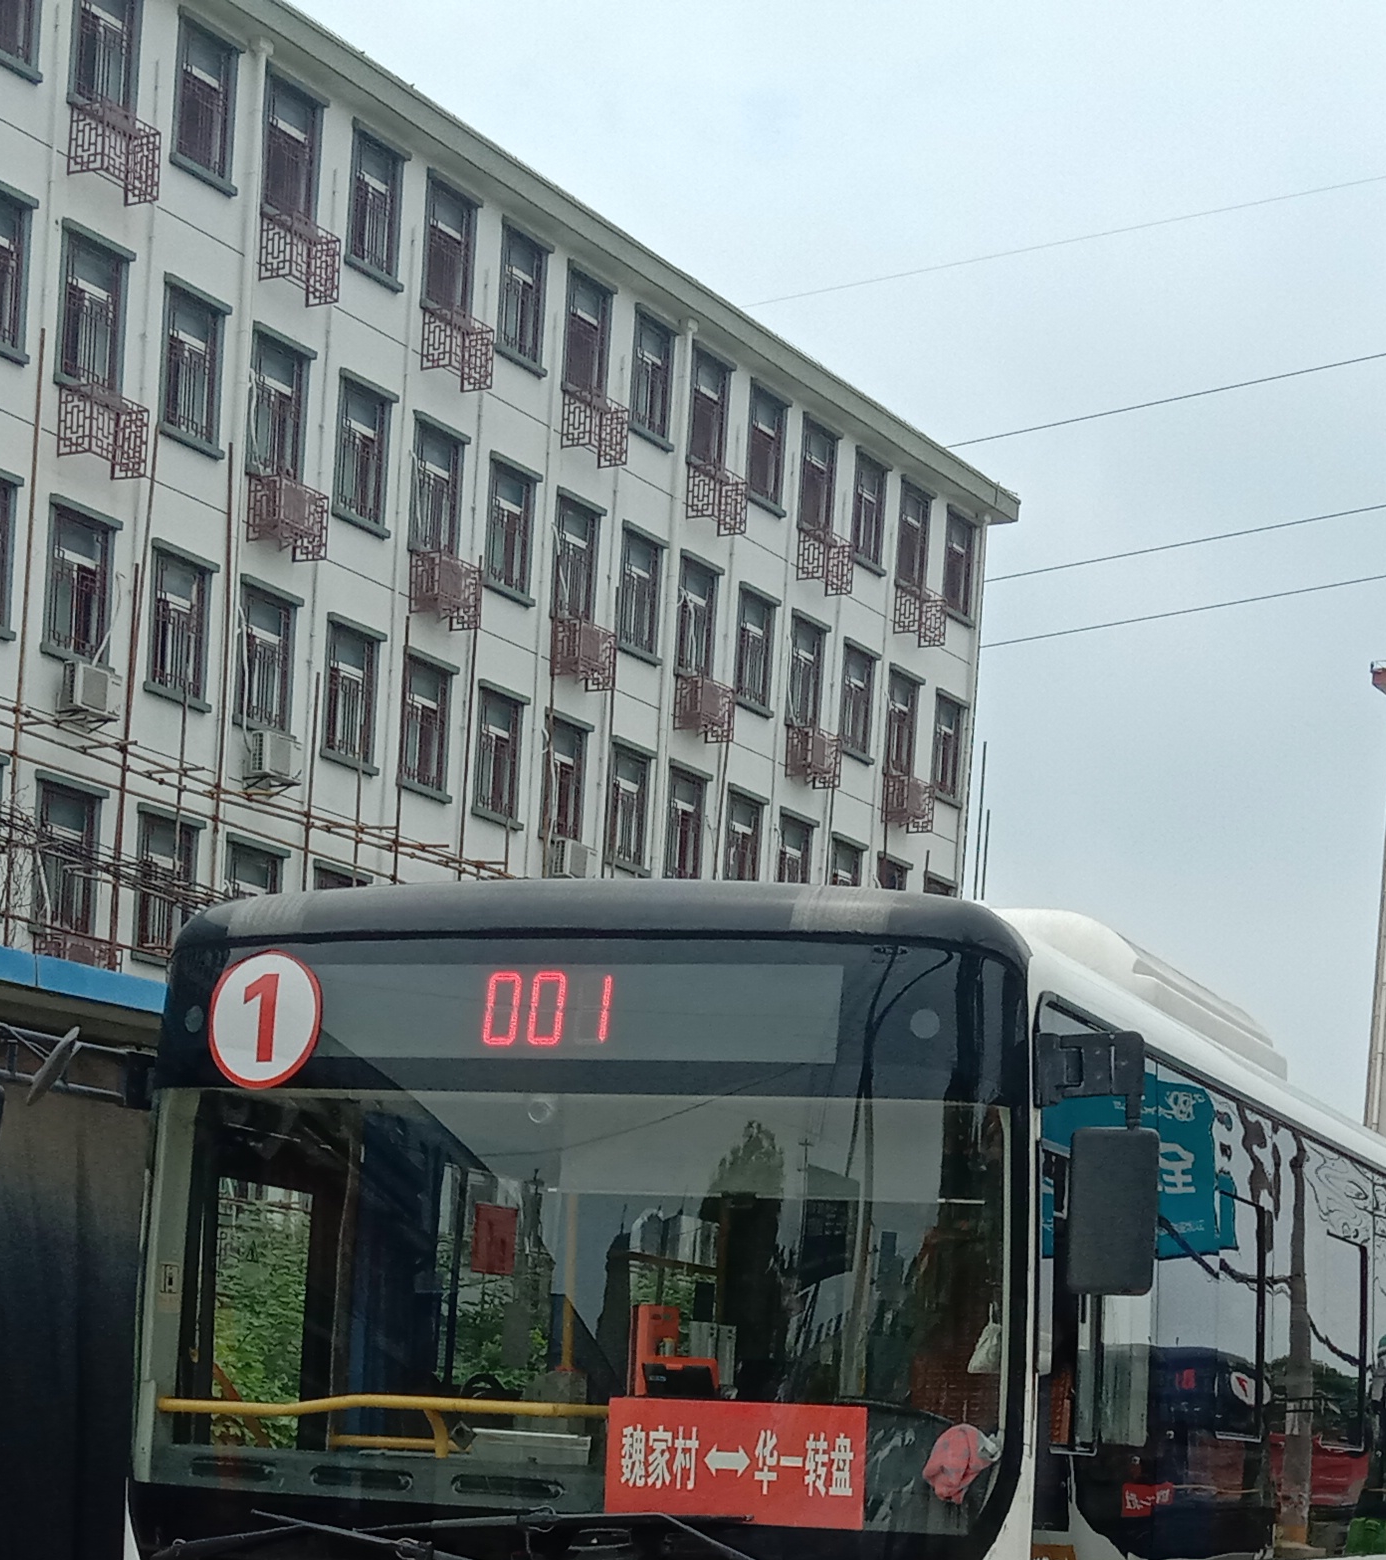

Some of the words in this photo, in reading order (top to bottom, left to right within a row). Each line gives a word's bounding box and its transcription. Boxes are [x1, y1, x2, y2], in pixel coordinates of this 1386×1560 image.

[243, 973, 280, 1063] 1
[482, 970, 613, 1046] 001
[620, 1424, 700, 1490] 魏家村
[754, 1429, 855, 1498] 华一转盘
